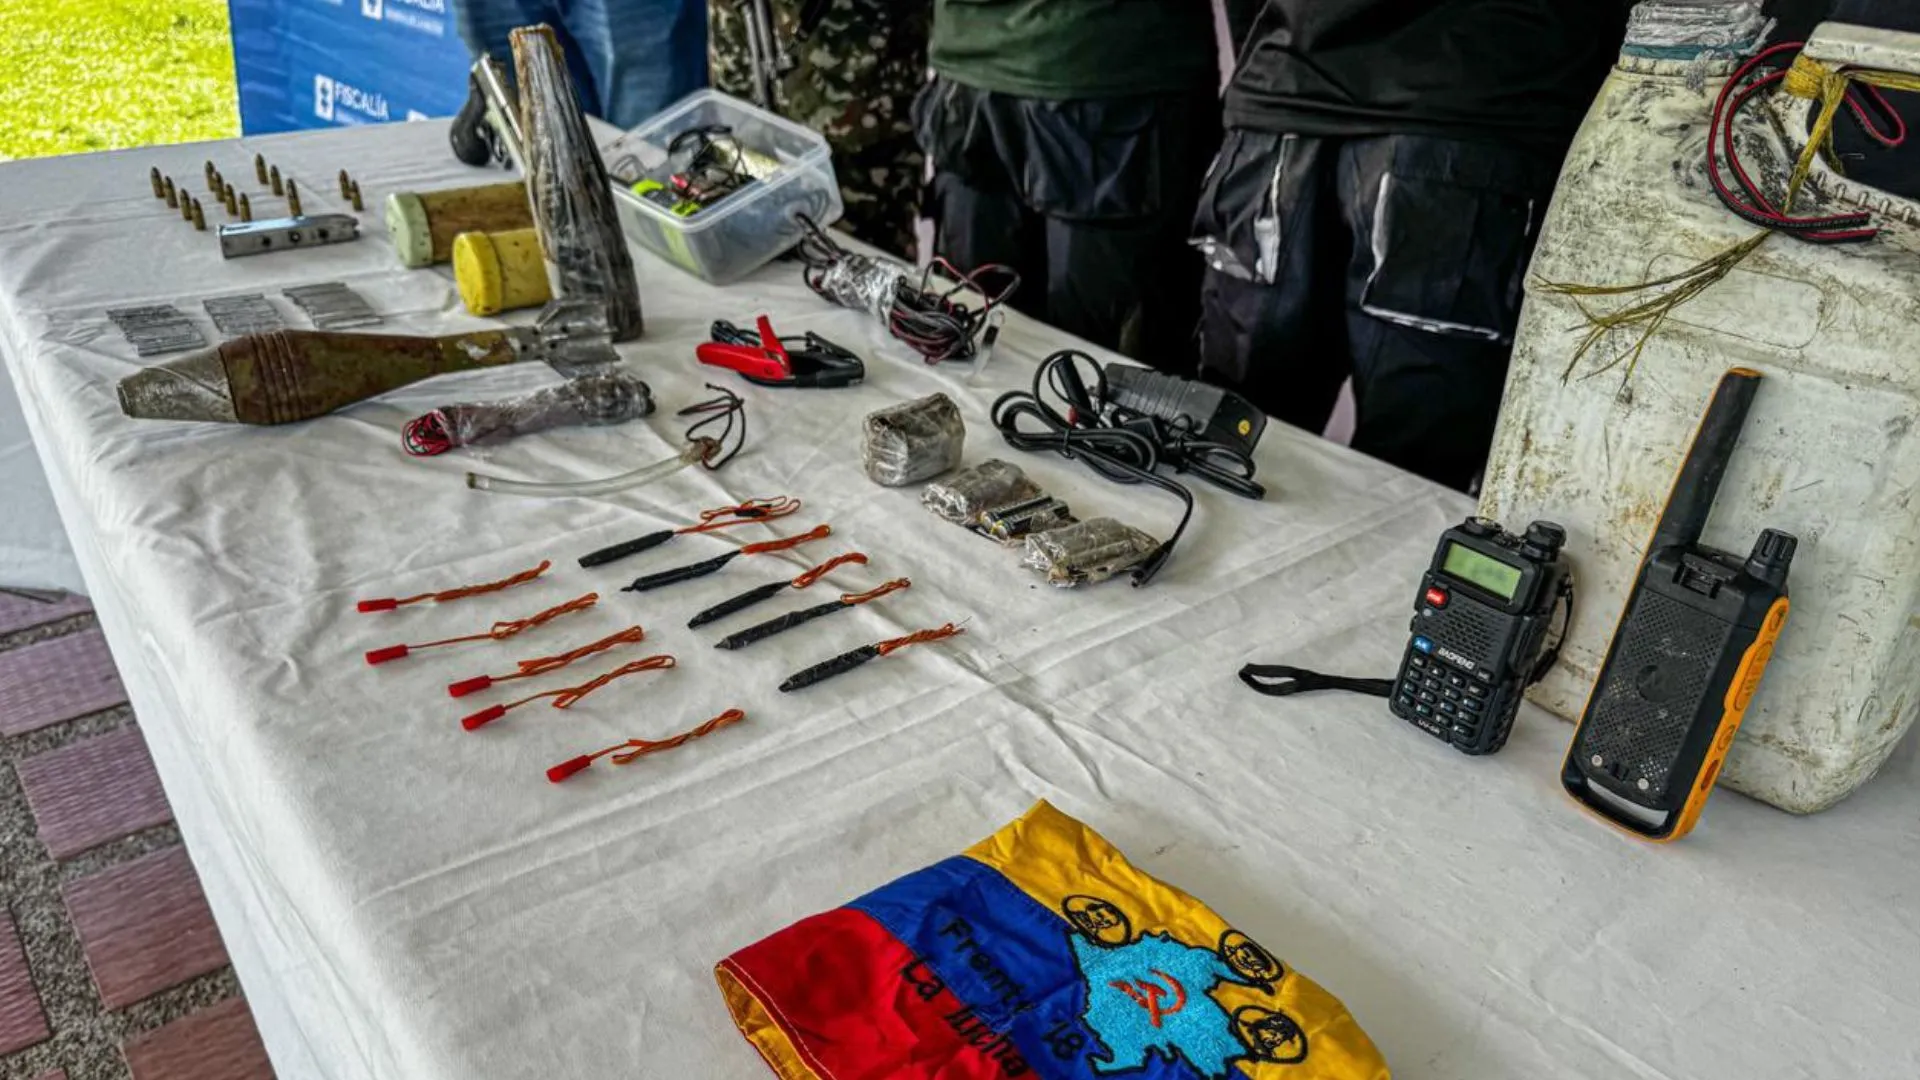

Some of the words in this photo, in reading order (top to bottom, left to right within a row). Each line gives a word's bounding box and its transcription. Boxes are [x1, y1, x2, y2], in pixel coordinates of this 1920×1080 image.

[335, 80, 389, 120] FISCALÍA
[1438, 647, 1475, 670] BAOFENG
[902, 956, 945, 1002] La
[1042, 1021, 1085, 1061] 18
